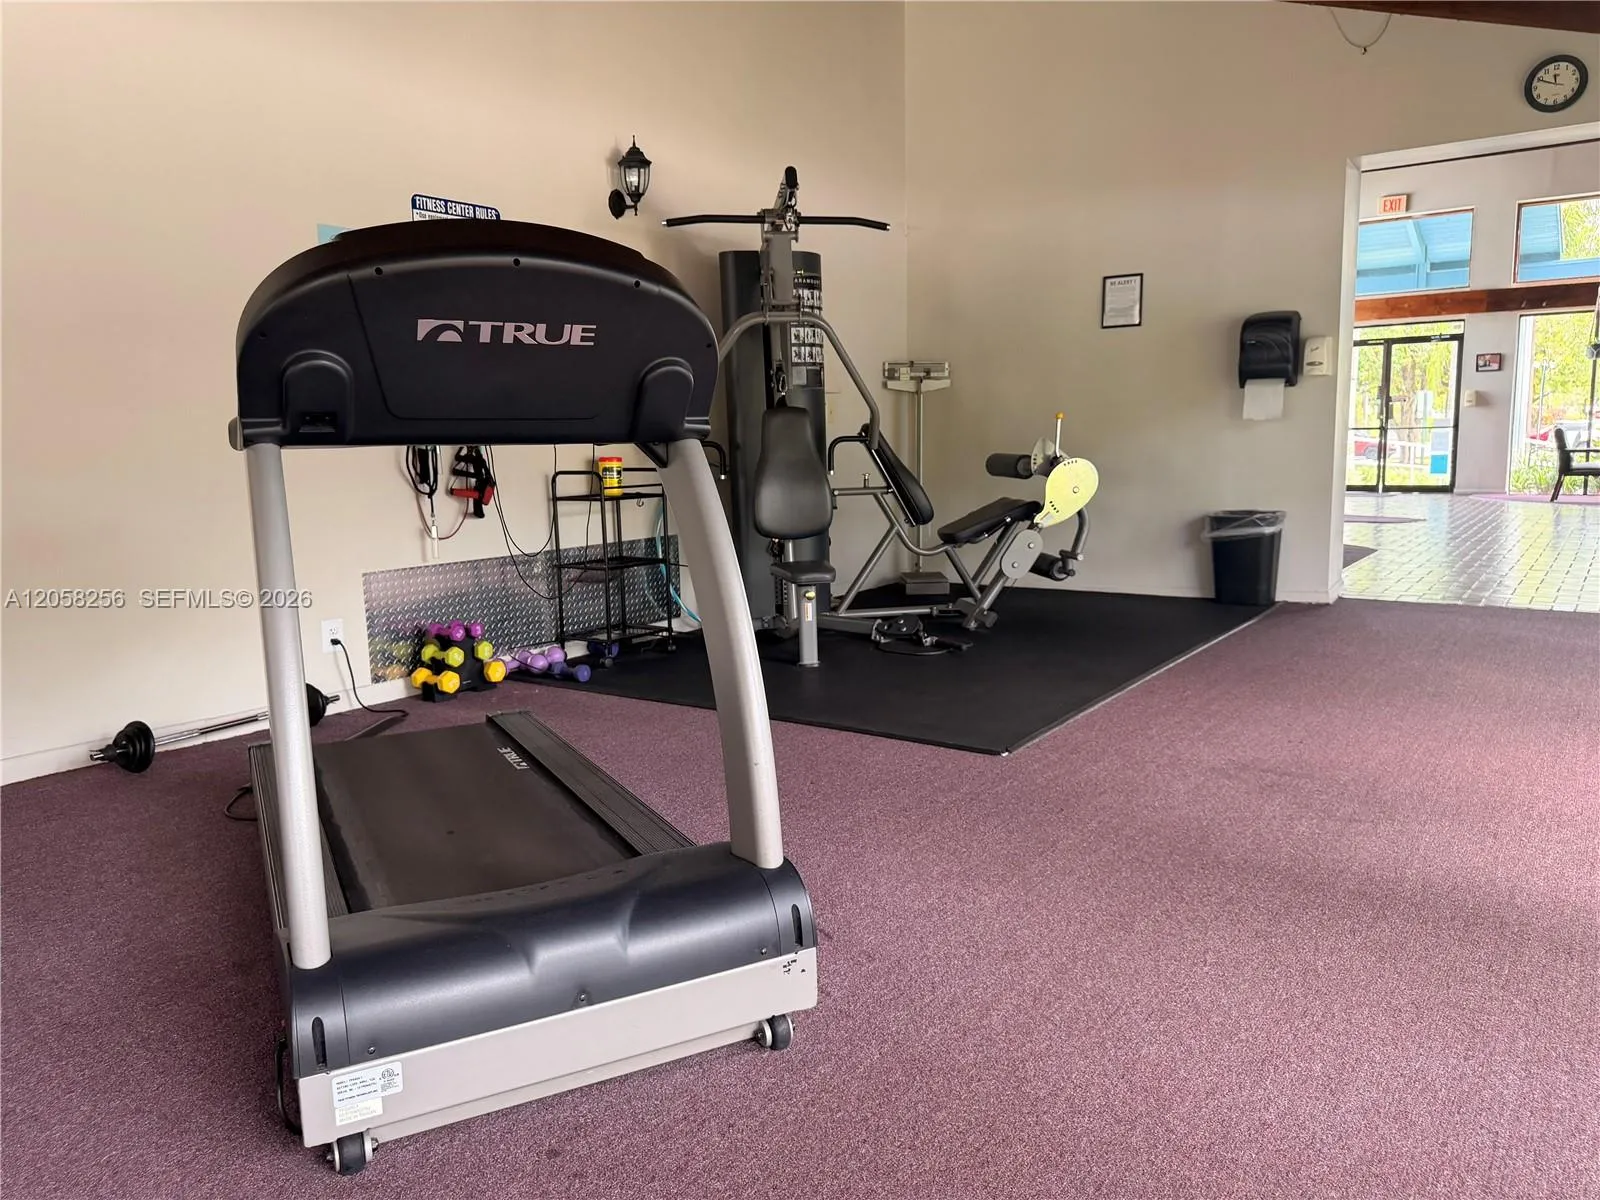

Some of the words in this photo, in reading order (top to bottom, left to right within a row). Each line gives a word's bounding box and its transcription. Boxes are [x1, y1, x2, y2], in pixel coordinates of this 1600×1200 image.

[1553, 63, 1560, 71] 12
[1543, 97, 1549, 105] 7
[415, 196, 446, 214] FITNESS
[447, 201, 475, 218] CENTER
[475, 206, 497, 220] RULES
[1383, 198, 1402, 213] EXIT
[468, 320, 597, 346] TRUE
